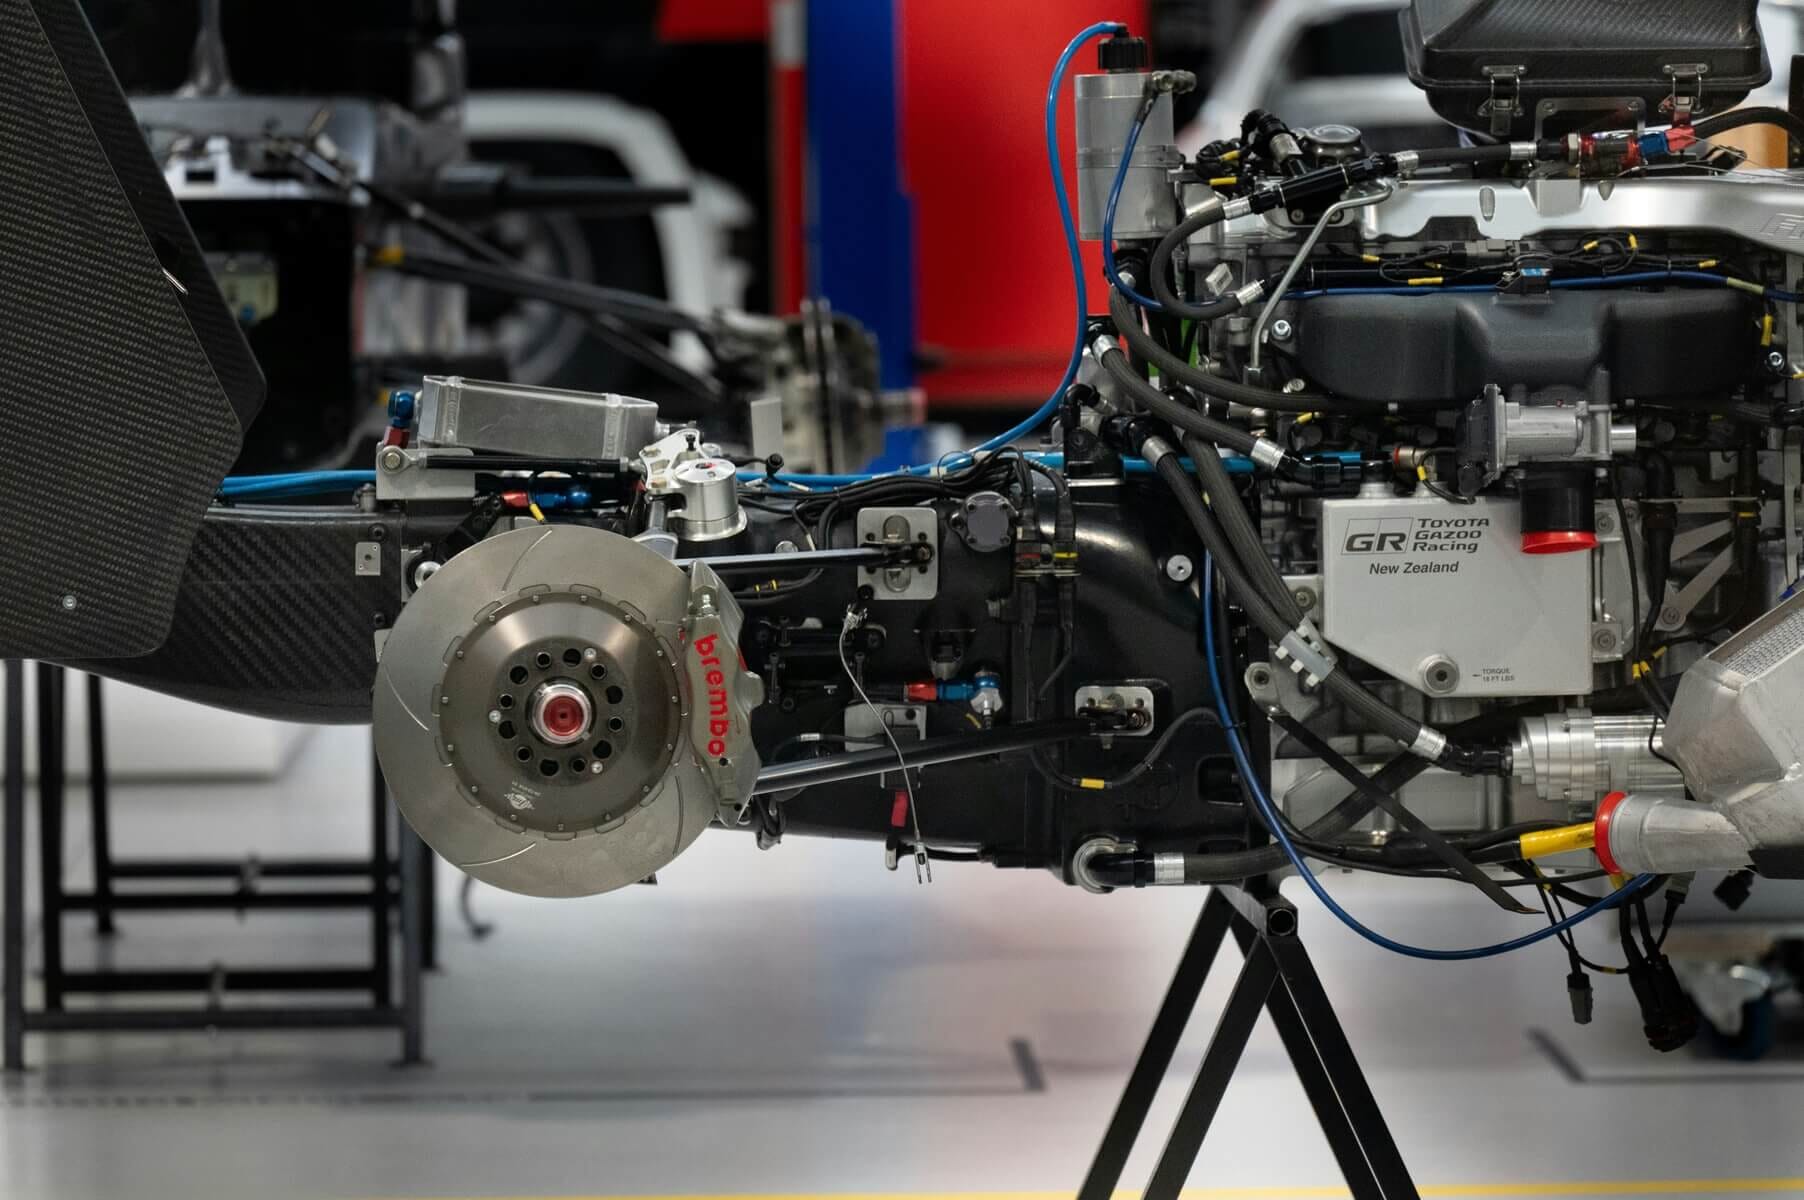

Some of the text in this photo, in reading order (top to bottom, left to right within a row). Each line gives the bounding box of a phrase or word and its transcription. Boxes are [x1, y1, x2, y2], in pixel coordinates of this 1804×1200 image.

[1417, 518, 1490, 528] TOYOTA
[1415, 530, 1482, 540] GAZOO
[1345, 532, 1407, 552] GR
[1412, 541, 1478, 554] Racing
[1369, 561, 1459, 575] New Zealand
[693, 633, 730, 757] brembo
